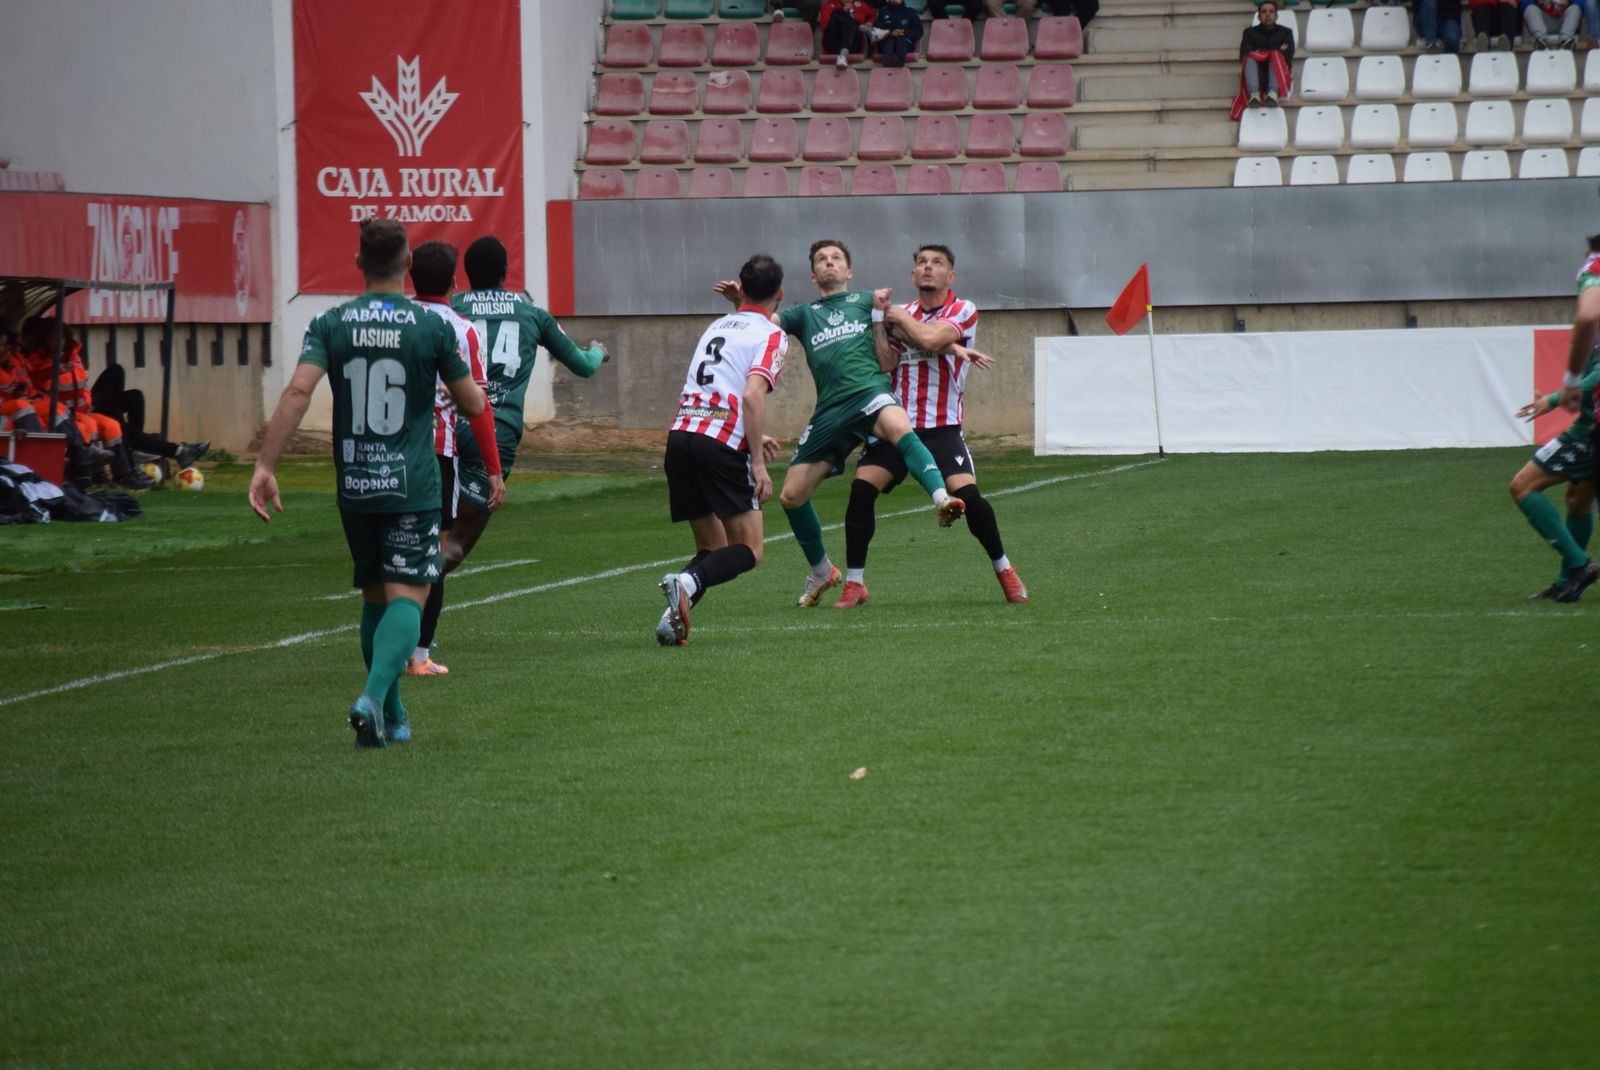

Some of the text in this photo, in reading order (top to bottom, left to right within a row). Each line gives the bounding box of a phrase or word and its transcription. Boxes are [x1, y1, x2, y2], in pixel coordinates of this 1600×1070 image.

[317, 167, 504, 199] CAJA RURAL
[351, 205, 473, 222] DE ZAMORA
[472, 302, 514, 315] ADILSON
[352, 328, 401, 349] LASURE
[696, 336, 726, 387] 2
[343, 357, 406, 435] 16
[357, 442, 387, 453] JUNTA
[366, 452, 405, 463] GALICIA
[345, 475, 399, 494] Bopeixe
